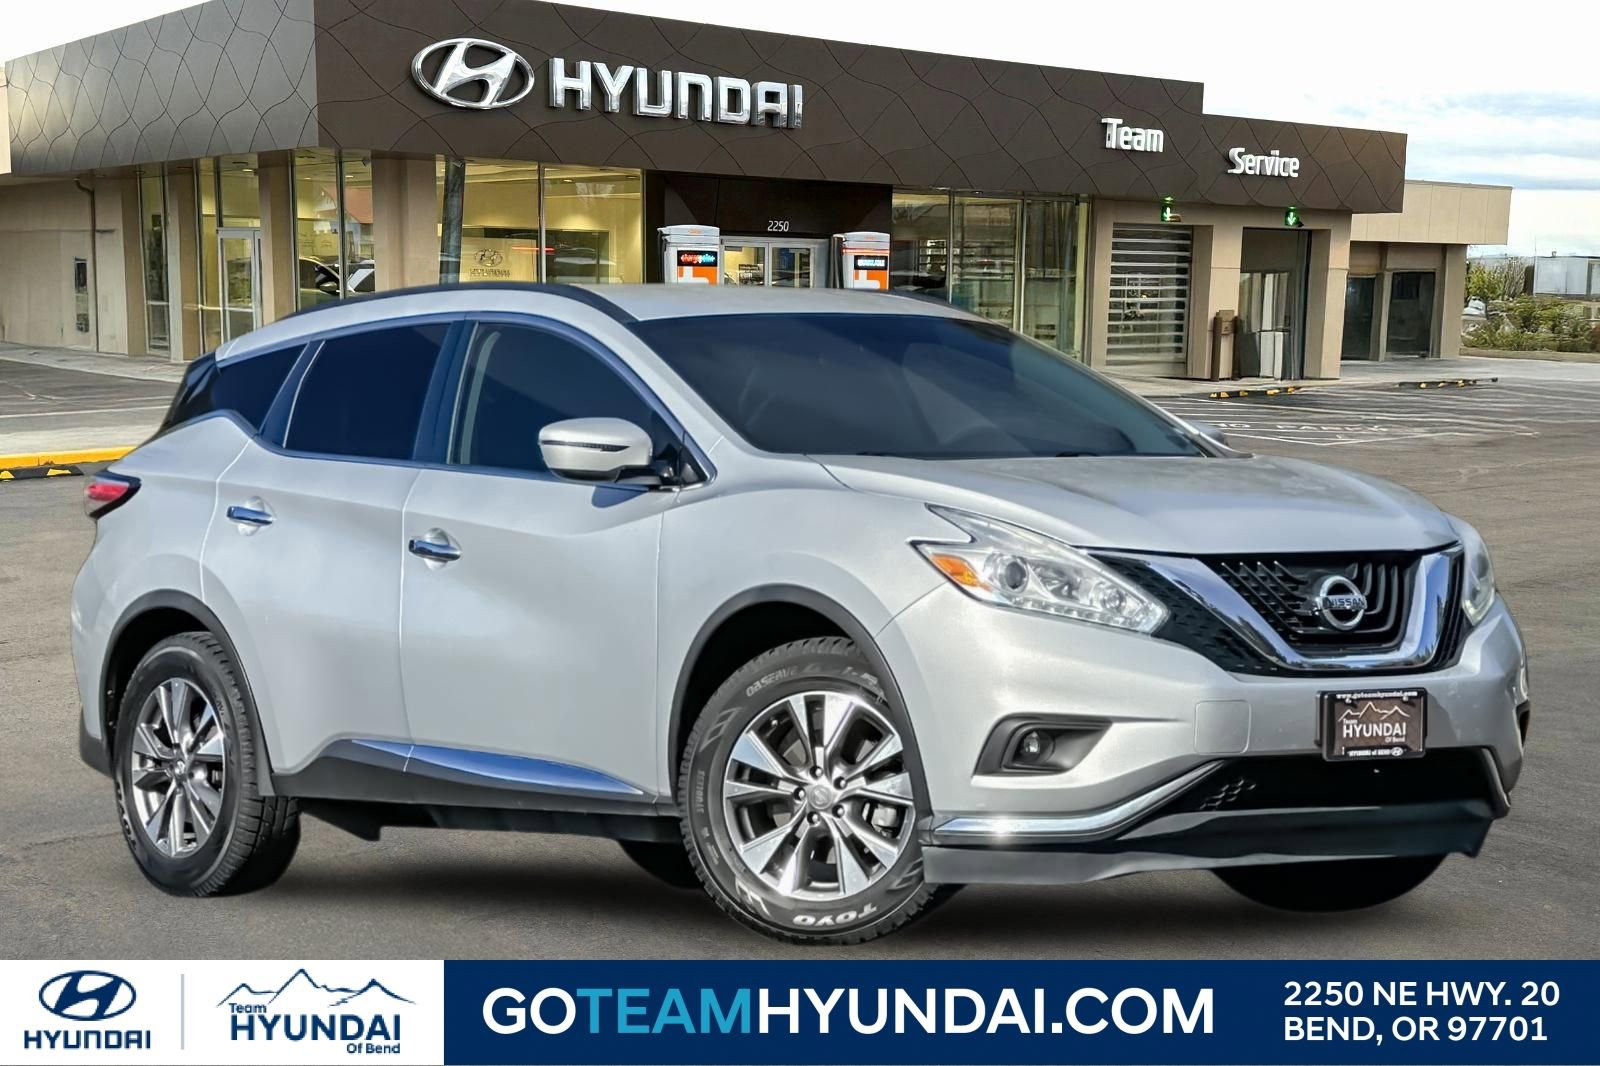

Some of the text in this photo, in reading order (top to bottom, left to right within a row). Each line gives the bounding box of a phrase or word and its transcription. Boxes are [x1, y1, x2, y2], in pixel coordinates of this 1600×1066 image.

[549, 57, 803, 129] HYUNDAI
[1101, 117, 1164, 153] Team
[1227, 147, 1300, 178] Service
[767, 220, 790, 232] 2250
[1328, 596, 1365, 607] NISSAN
[1343, 722, 1407, 738] HYUNDAI
[792, 902, 878, 926] TOYO
